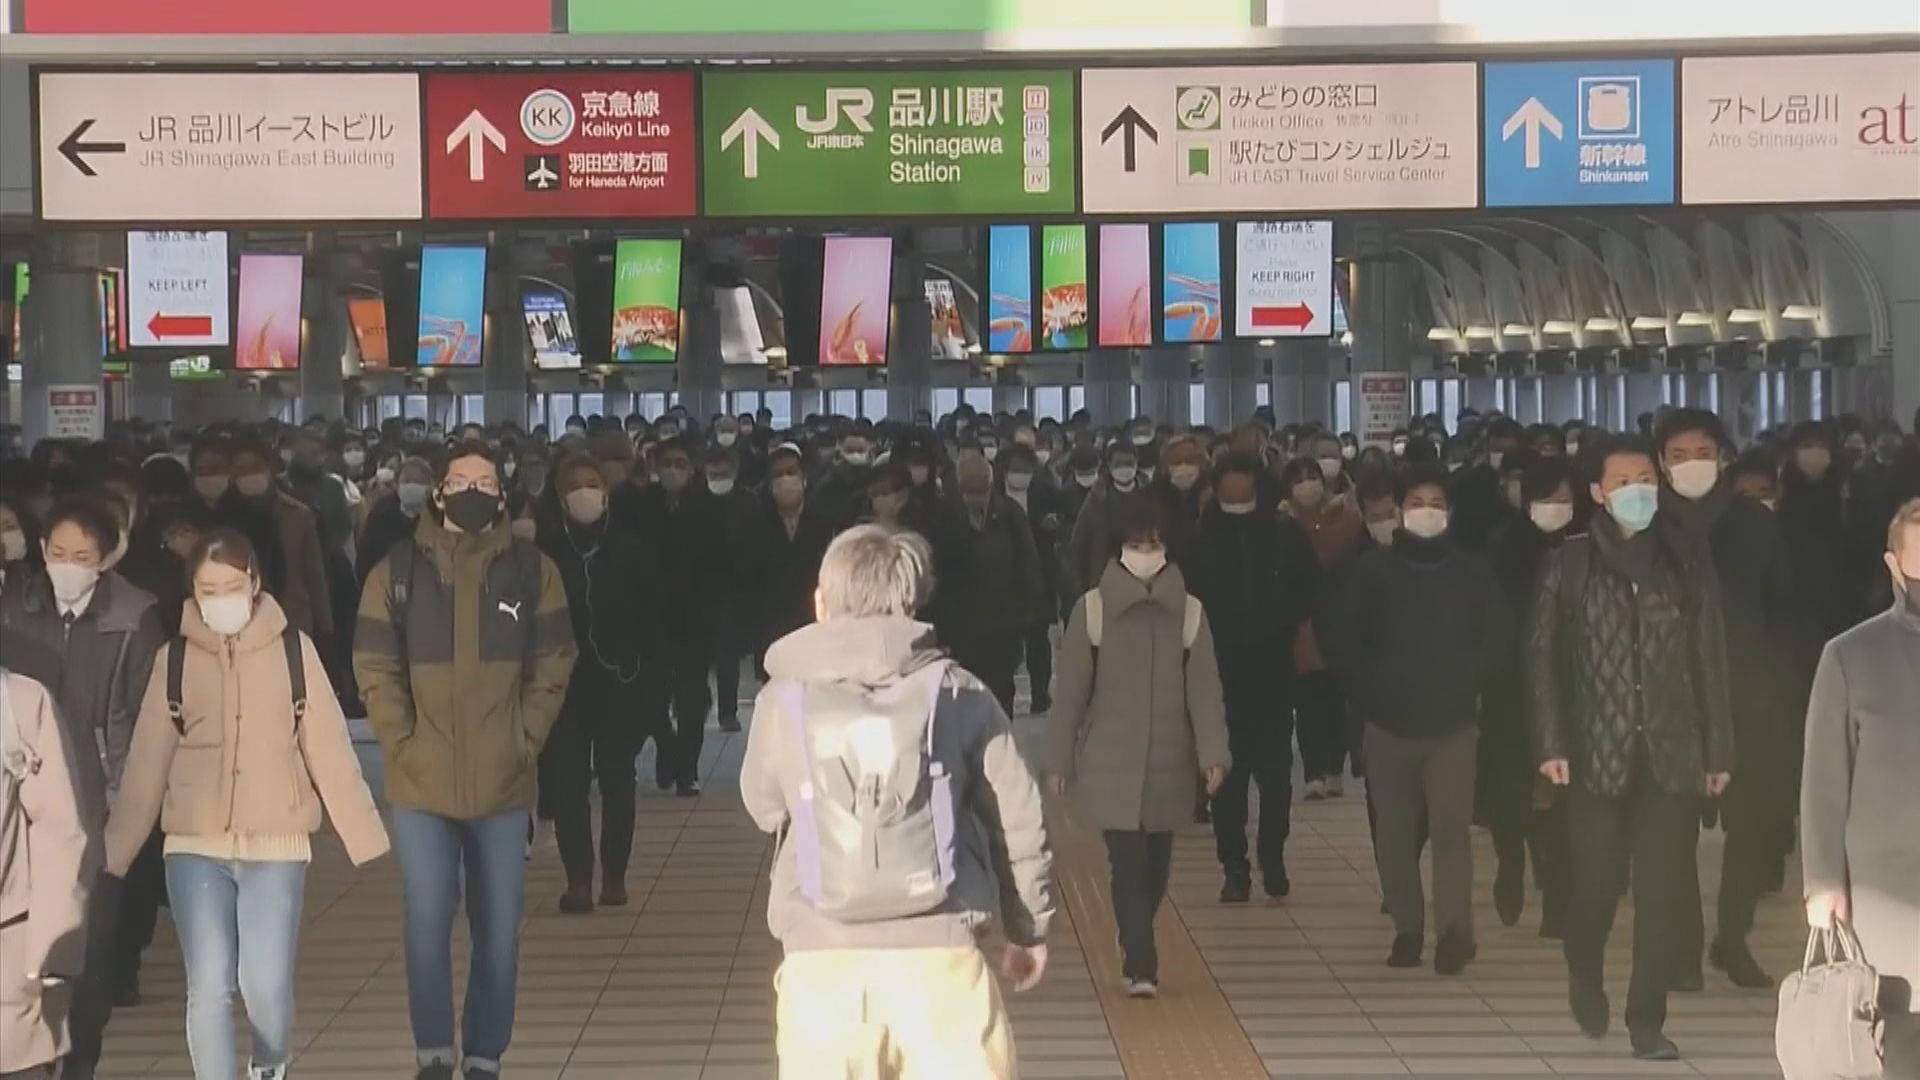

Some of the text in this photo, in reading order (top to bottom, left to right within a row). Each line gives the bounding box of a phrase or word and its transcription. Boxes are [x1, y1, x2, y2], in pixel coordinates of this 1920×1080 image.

[581, 90, 660, 118] 京急線
[889, 85, 1005, 127] 品川駅
[1229, 83, 1377, 109] みどりの窓口
[532, 107, 563, 127] KK
[795, 87, 875, 133] JR
[1708, 92, 1839, 125] アトレ品川
[138, 112, 394, 144] JR 品川イーストビル
[637, 120, 671, 137] Line
[1231, 115, 1274, 129] Ticket
[1279, 114, 1324, 129] Office
[806, 133, 865, 150] JR東日本
[889, 133, 1003, 158] Shinagawa
[1229, 138, 1451, 164] 駅たびコンシェルジュ
[1747, 130, 1838, 150] Shinagawa
[139, 148, 395, 171] JR Shinagawa East Building
[568, 151, 668, 174] 羽田空港方面
[1579, 144, 1647, 167] 新幹線
[569, 175, 665, 190] for Haneda Airport
[889, 161, 961, 183] Station
[1230, 166, 1445, 184] JR EAST Travel Service Center
[1579, 168, 1649, 184] Shinkansen
[148, 279, 208, 292] KEEP LEFT
[1251, 270, 1316, 283] KEEP RIGHT
